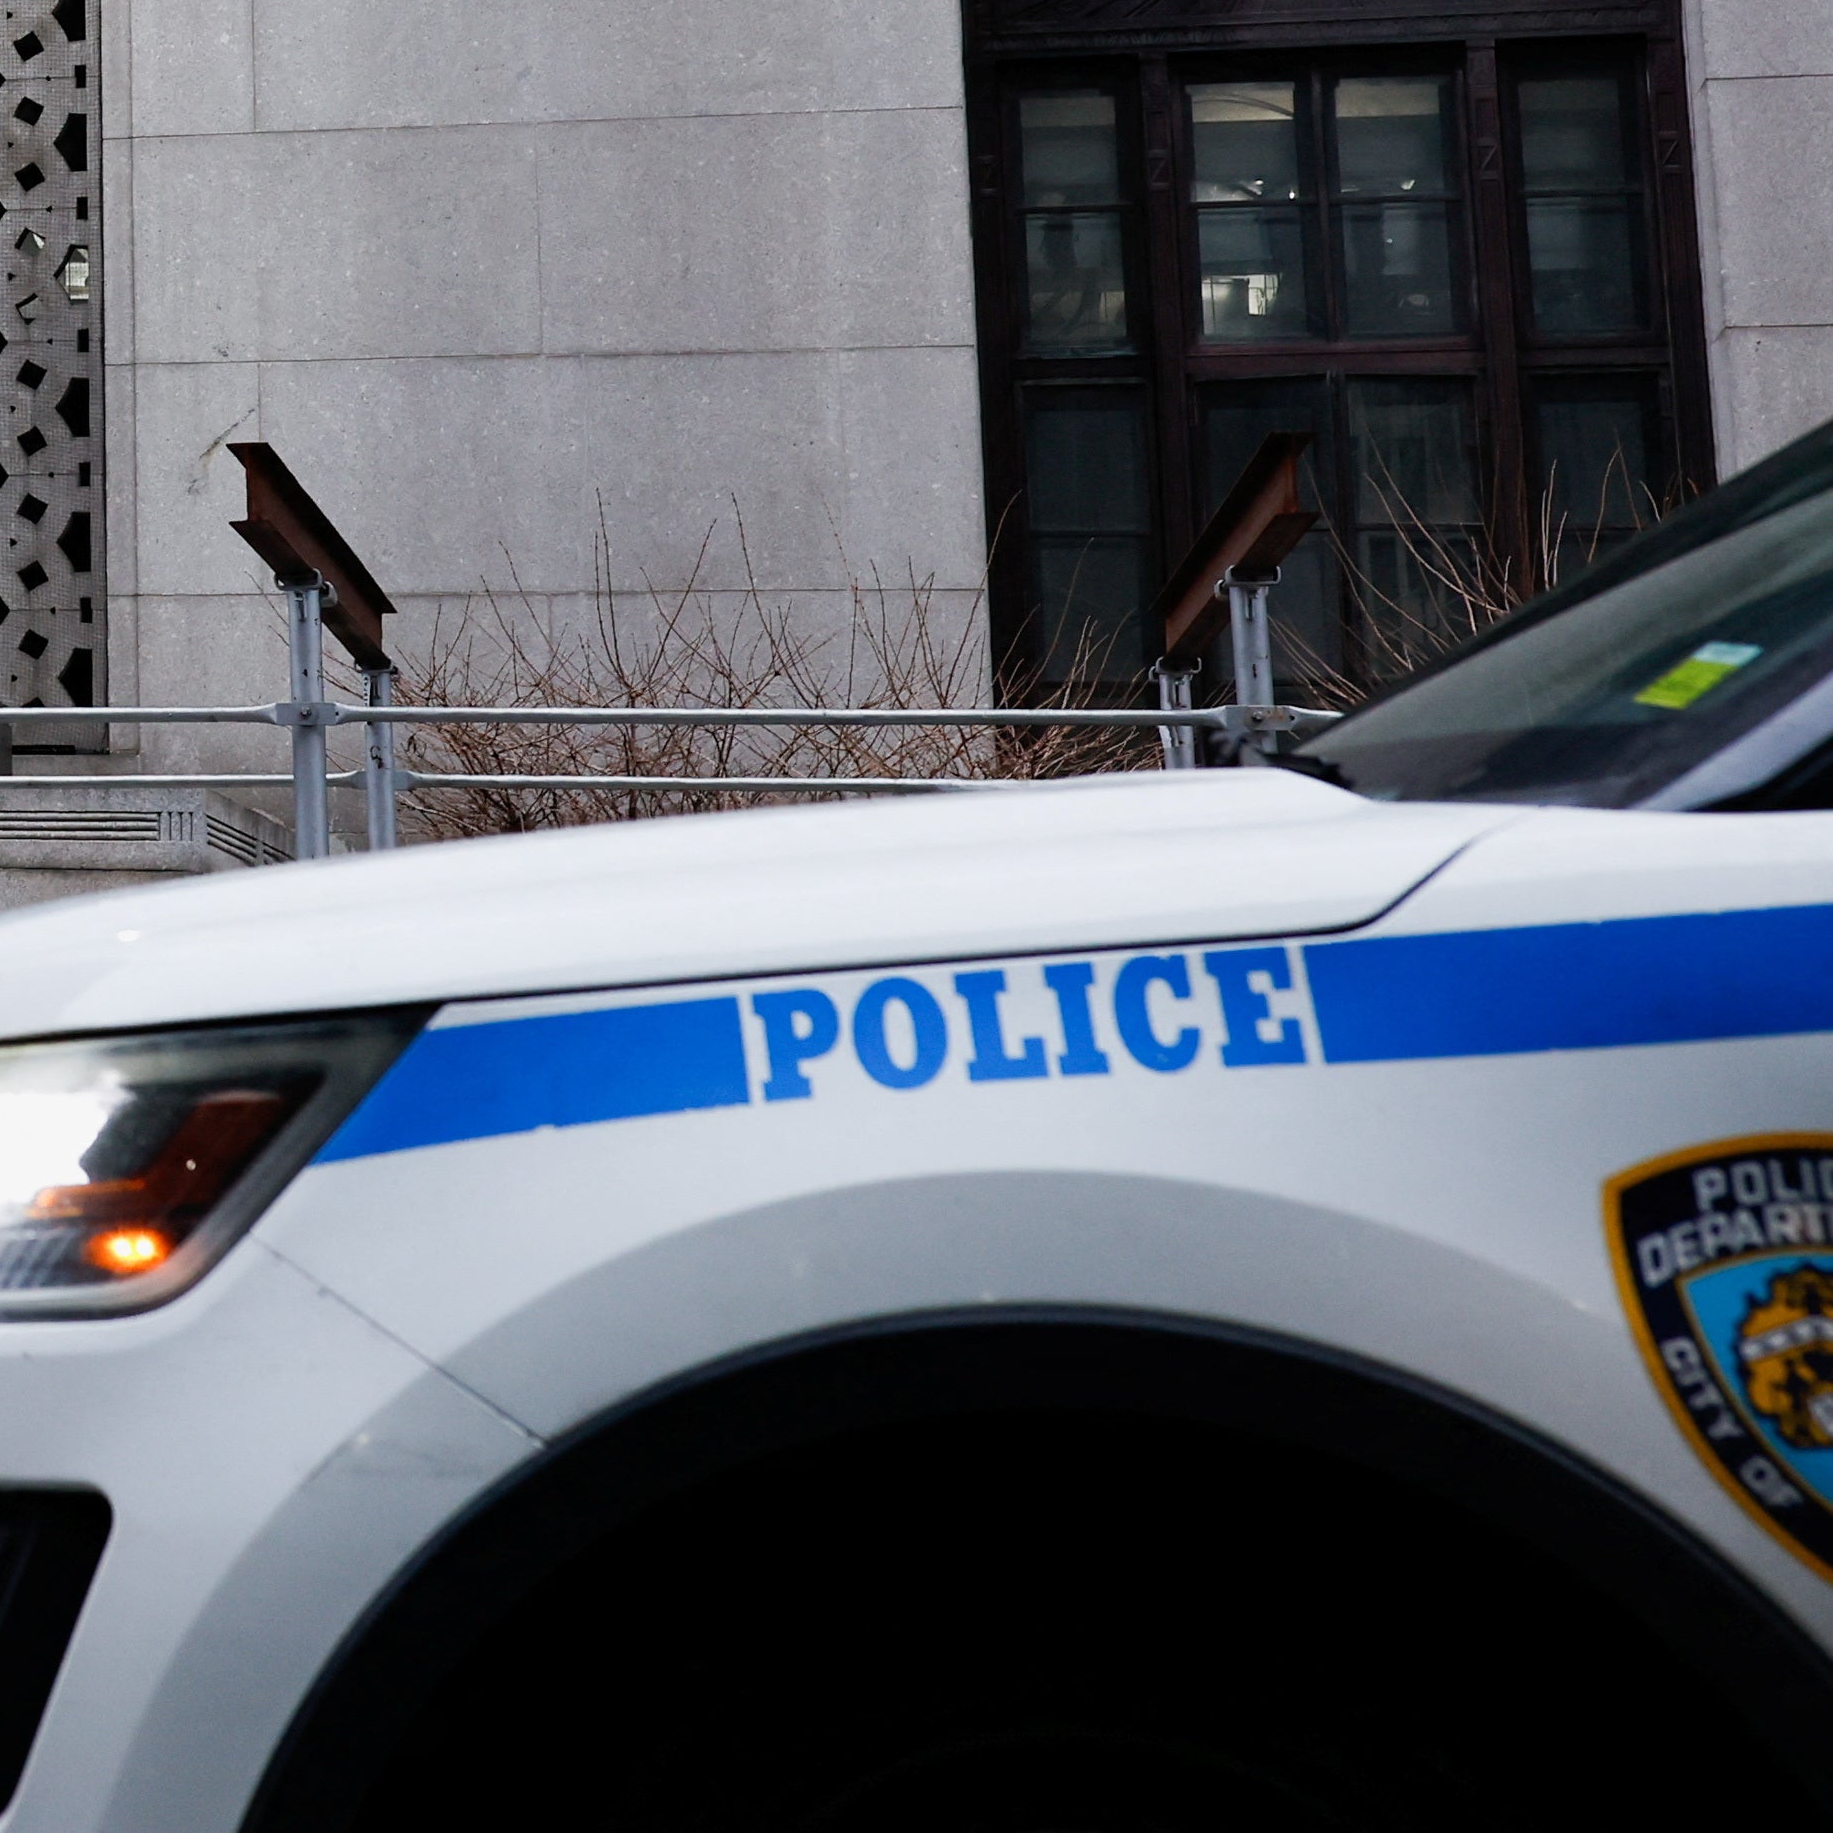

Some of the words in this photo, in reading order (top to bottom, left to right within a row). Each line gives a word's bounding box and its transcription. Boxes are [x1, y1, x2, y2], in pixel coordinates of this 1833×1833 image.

[751, 946, 1308, 1103] POLICE
[1660, 1335, 1745, 1441] CITY
[1740, 1454, 1804, 1509] OF
